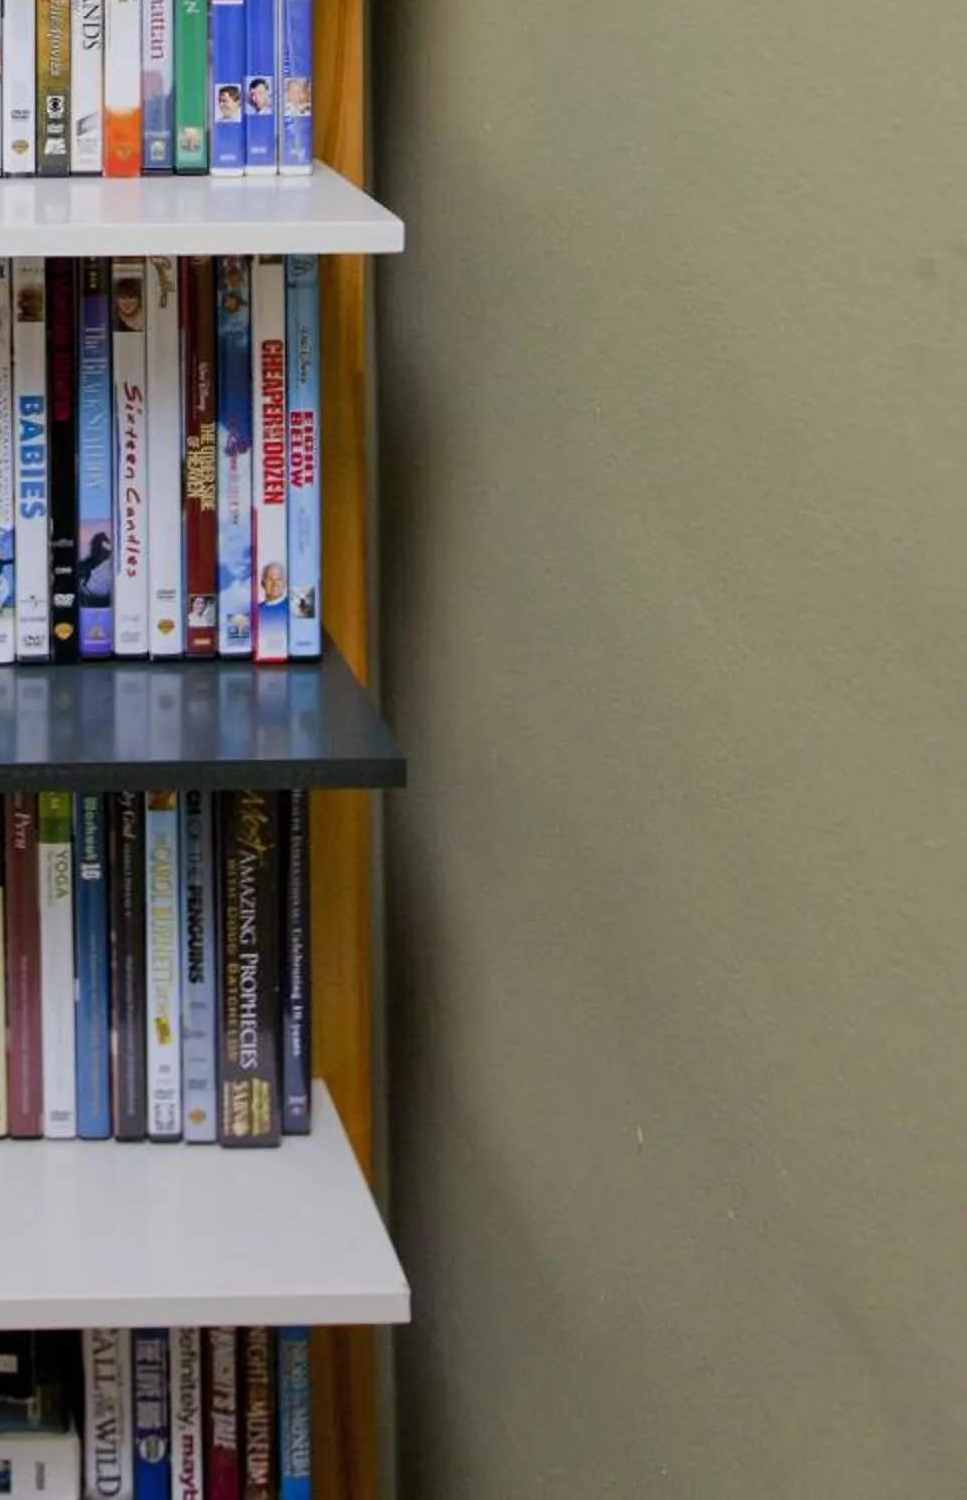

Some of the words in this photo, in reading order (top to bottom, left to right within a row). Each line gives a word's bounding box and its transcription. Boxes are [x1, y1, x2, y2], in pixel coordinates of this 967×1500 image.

[261, 340, 284, 426] CHEAPER
[19, 396, 46, 520] BABIES
[125, 382, 143, 480] Sixteen
[200, 422, 214, 443] THE
[290, 411, 303, 490] BELOW
[263, 442, 285, 504] DOZEN
[126, 488, 142, 579] Candles
[55, 850, 69, 898] YOGA
[226, 859, 236, 894] WITH
[239, 851, 259, 944] AMAZING
[227, 907, 237, 954] DOUG
[227, 964, 238, 1061] BATCHELOR
[240, 953, 259, 1068] PROPHECIES
[95, 1418, 121, 1497] WILD
